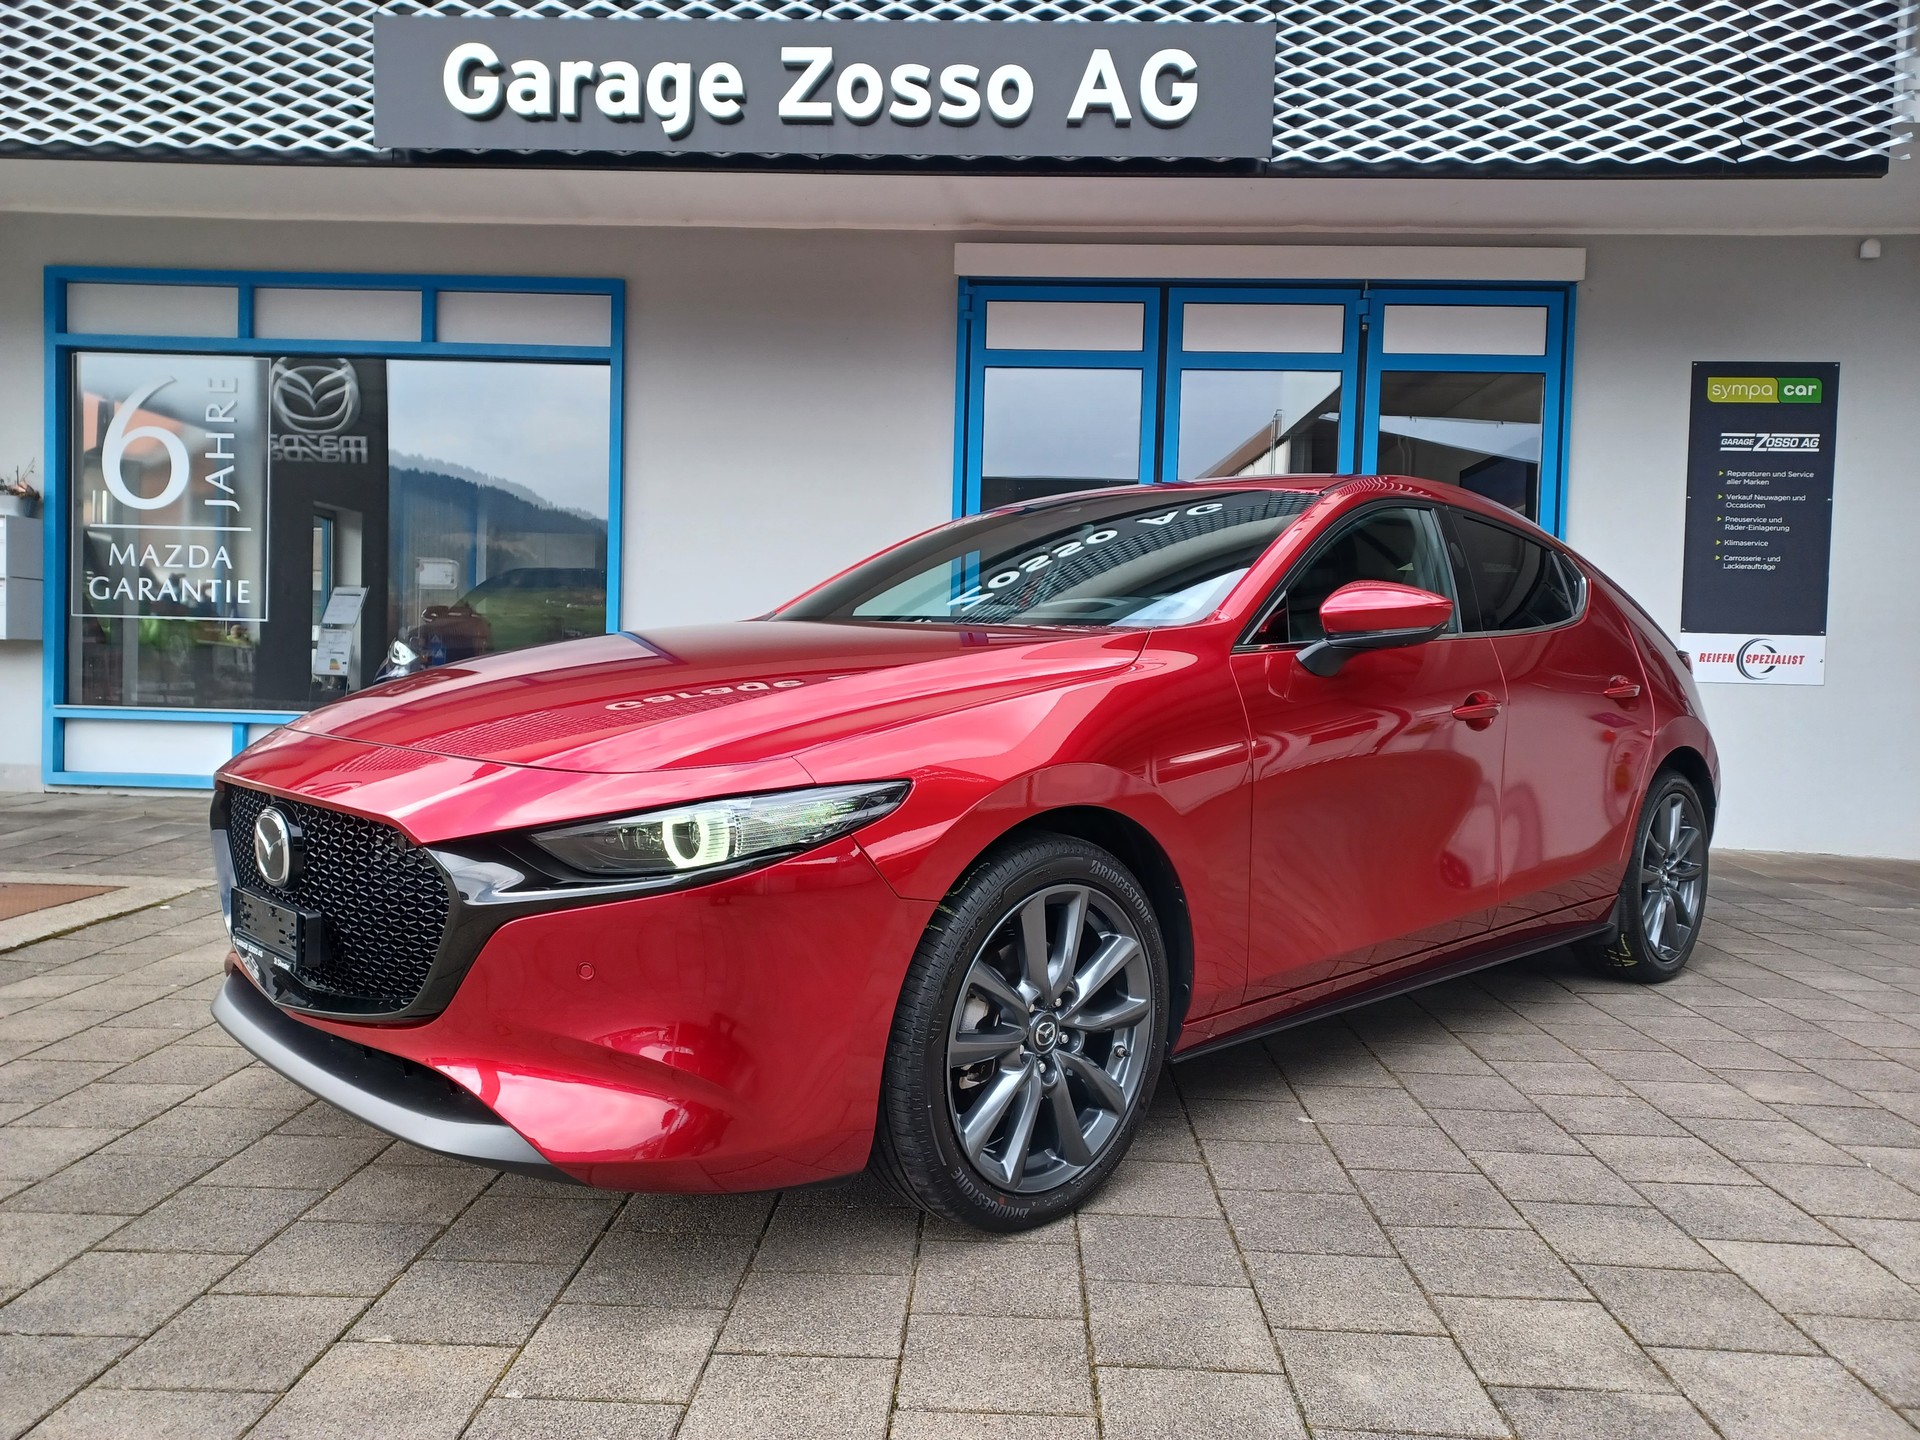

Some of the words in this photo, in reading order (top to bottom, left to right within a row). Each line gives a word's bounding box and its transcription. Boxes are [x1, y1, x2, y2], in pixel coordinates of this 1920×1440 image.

[443, 42, 746, 141] Garage
[778, 46, 1035, 126] Zosso
[1066, 48, 1199, 128] AG
[1712, 384, 1773, 400] sympa
[1783, 384, 1817, 396] car
[101, 375, 190, 511] 6
[204, 376, 241, 512] JAHRE
[1720, 438, 1755, 446] GARAGE
[1753, 432, 1799, 452] ZOSSO
[1800, 438, 1819, 448] AG
[1727, 470, 1771, 478] Reparaturen
[1754, 494, 1791, 502] Neuwagen
[1725, 524, 1790, 532] Räder-Einlagerung
[1724, 539, 1769, 547] Klimaservice
[108, 542, 233, 570] MAZDA
[1723, 563, 1776, 571] Lackieraufträge
[88, 576, 250, 604] GARANTIE
[1698, 652, 1735, 663] REIFEN
[1745, 654, 1805, 665] SPEZIALIST
[1088, 859, 1154, 926] BRIDGESTONE
